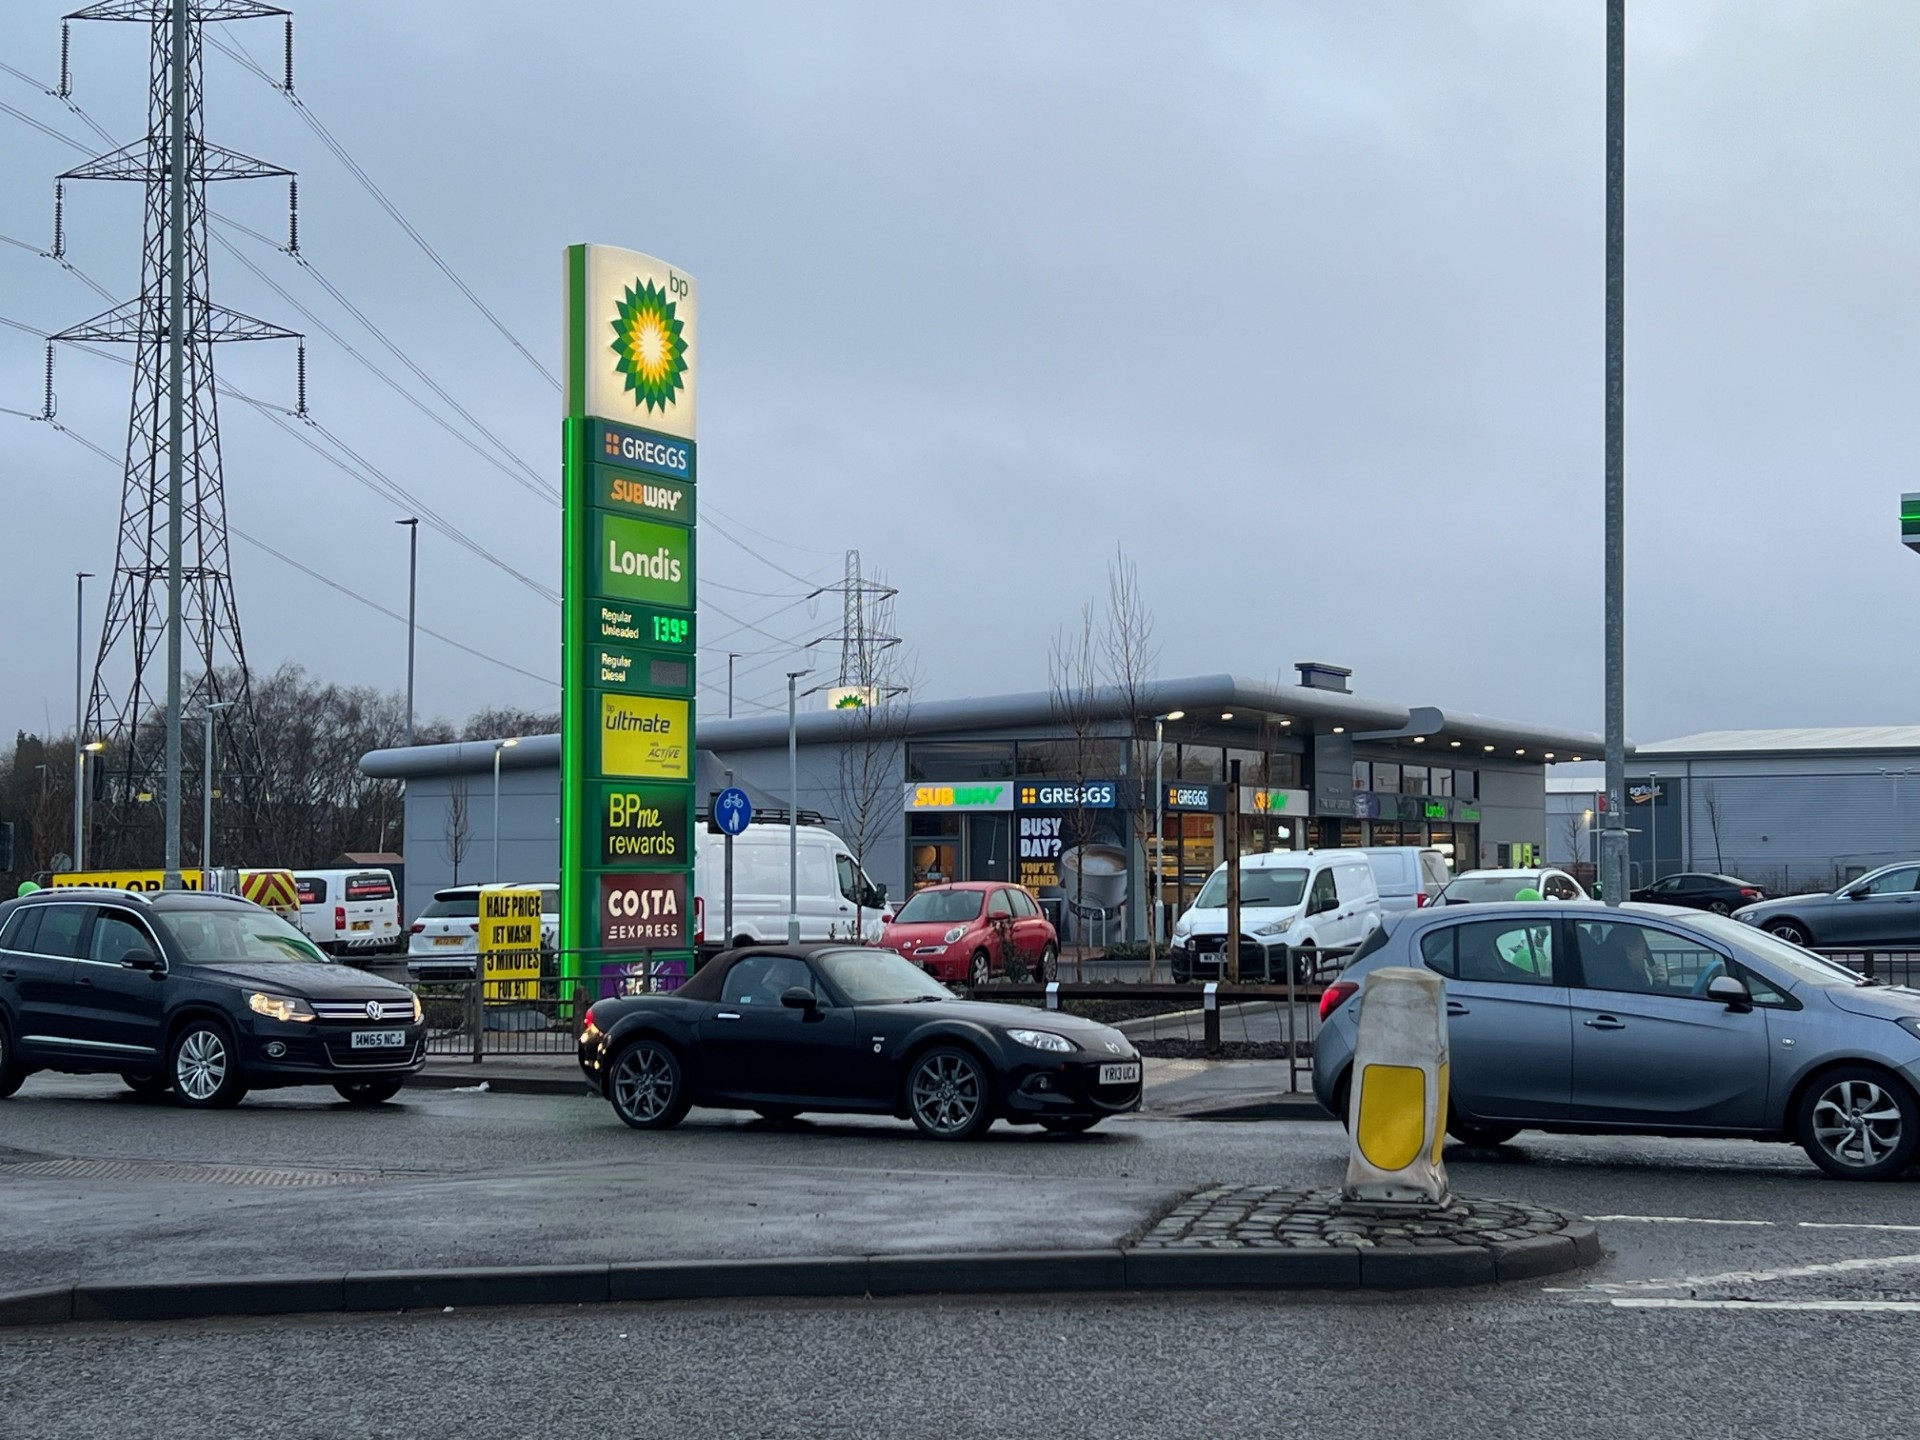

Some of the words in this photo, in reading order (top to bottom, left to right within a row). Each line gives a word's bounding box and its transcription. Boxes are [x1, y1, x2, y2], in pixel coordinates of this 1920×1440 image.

[669, 269, 688, 301] bp
[622, 437, 687, 470] GREGGS
[611, 479, 682, 511] SUBWAY
[609, 539, 681, 583] Londis
[601, 607, 632, 624] Regular
[601, 623, 640, 639] Unleaded
[601, 652, 632, 669] Regular
[601, 668, 626, 682] Diesel
[605, 710, 671, 734] ultimate
[913, 786, 1003, 807] SUBWAY
[1039, 787, 1111, 804] GREGGS
[1177, 789, 1208, 806] GREGGS
[1020, 817, 1062, 837] BUSY
[608, 830, 675, 855] rewards
[1020, 838, 1062, 858] DAY?
[1020, 862, 1055, 874] YOU'VE
[1020, 874, 1059, 887] EARNED
[486, 896, 510, 918] HALF
[511, 895, 541, 918] PRICE
[608, 889, 678, 920] COSTA
[492, 925, 506, 944] JET
[506, 924, 532, 944] WASH
[619, 923, 678, 940] EXPRESS
[495, 947, 540, 971] MINUTES
[1104, 1066, 1122, 1081] YR13
